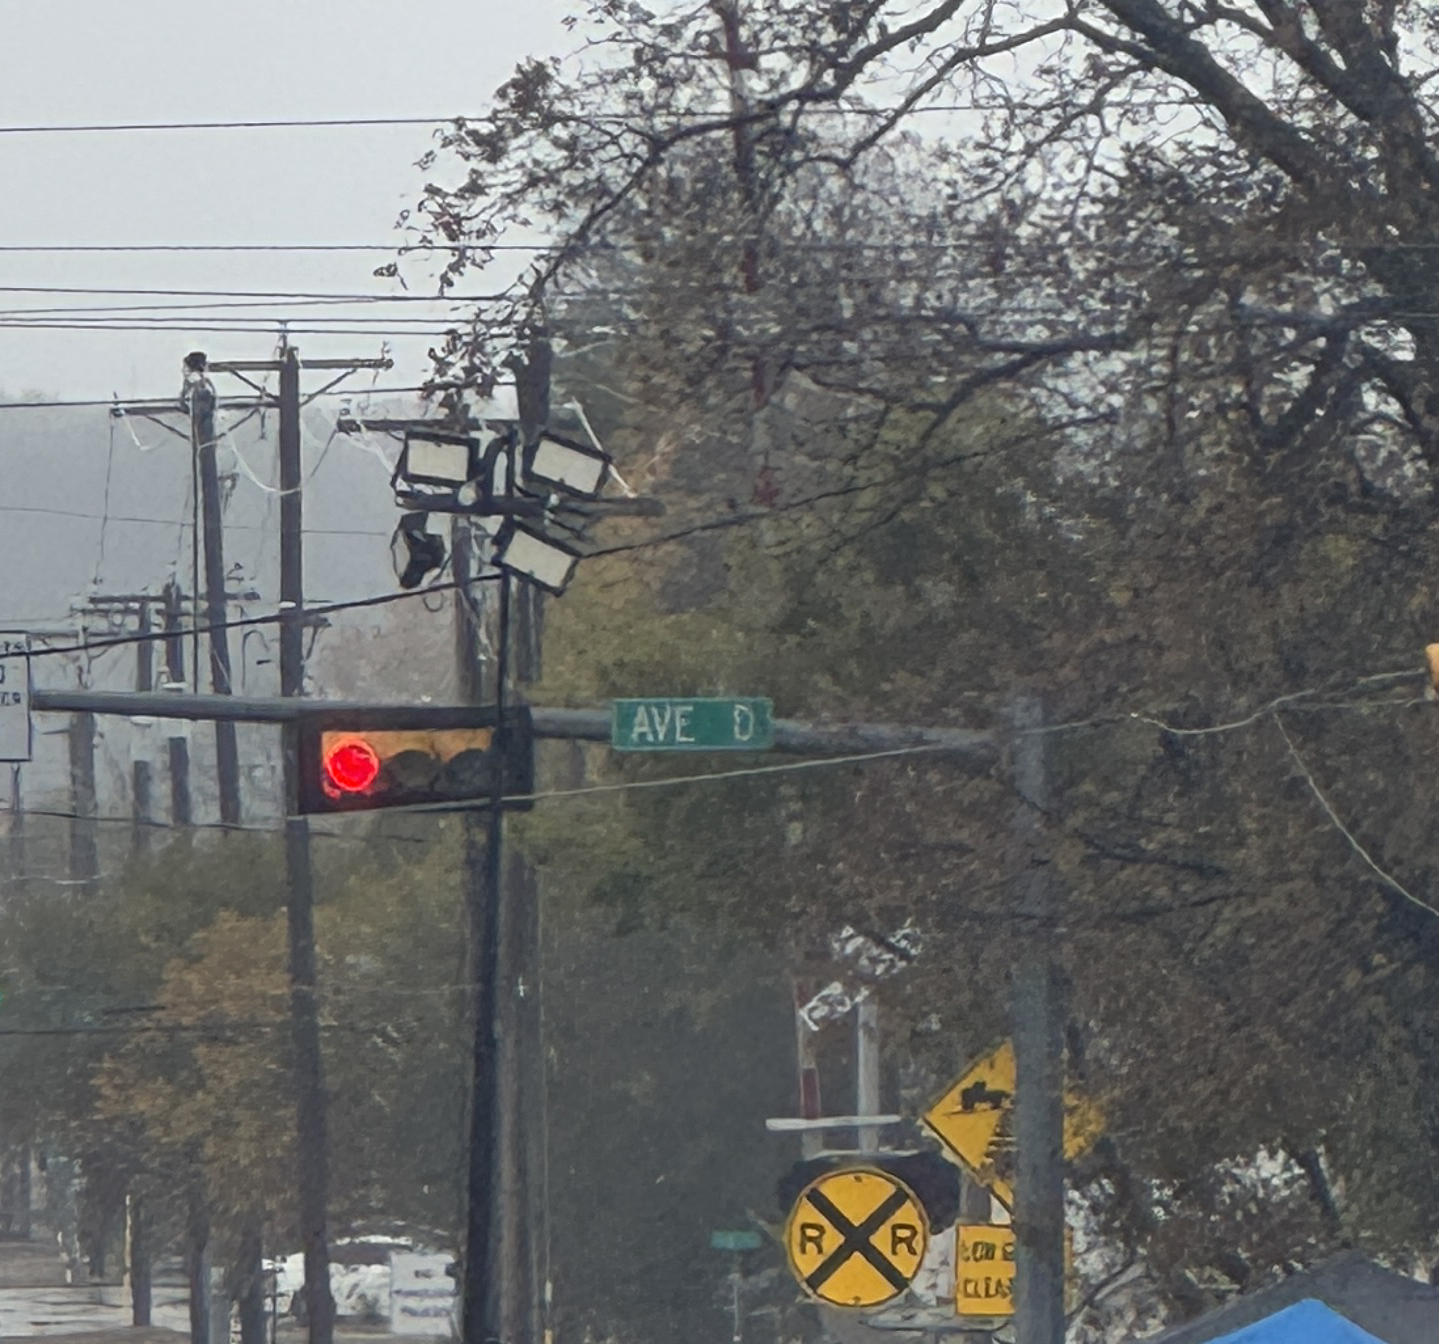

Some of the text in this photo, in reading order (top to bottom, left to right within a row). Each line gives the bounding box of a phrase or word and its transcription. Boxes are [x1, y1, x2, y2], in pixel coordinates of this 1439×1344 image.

[630, 703, 755, 742] AVE D
[799, 1222, 919, 1256] R R
